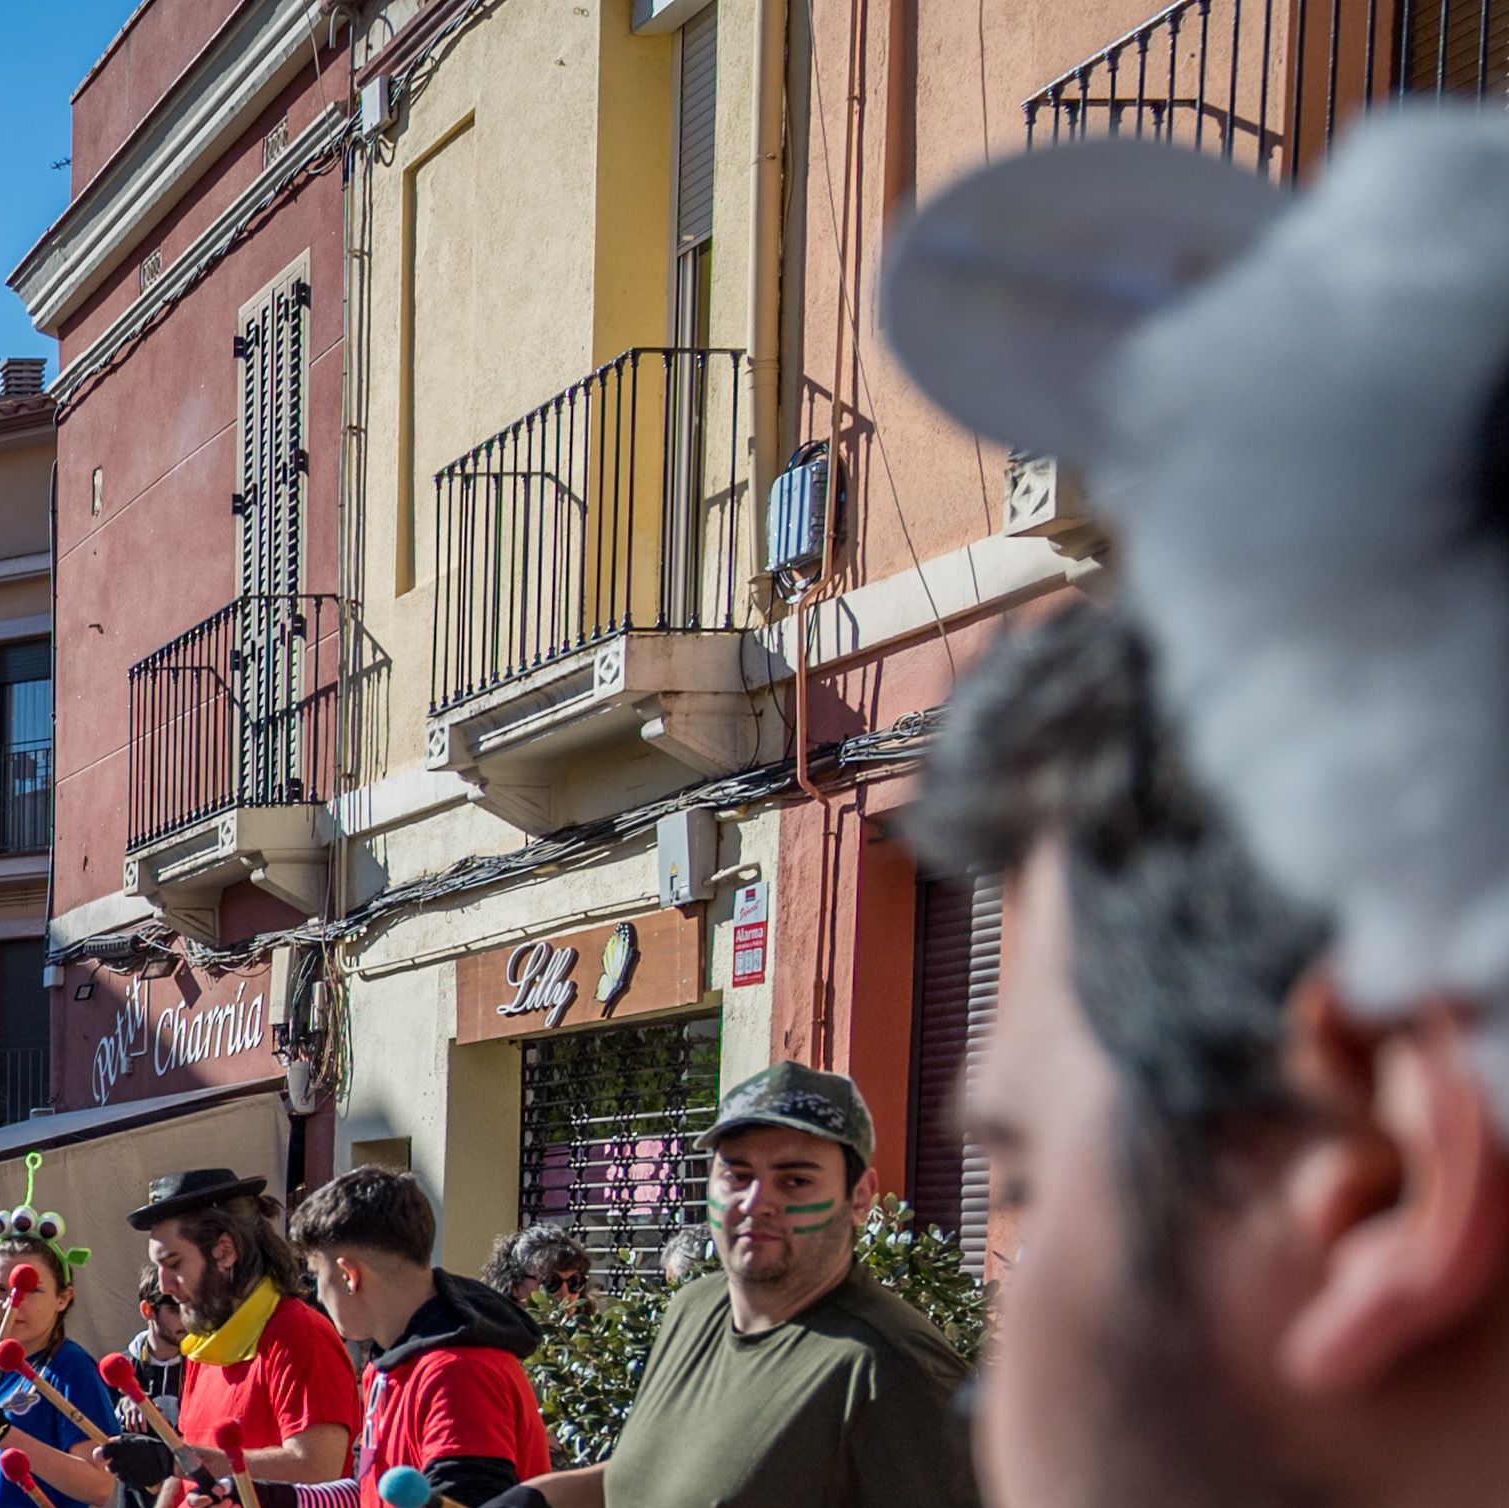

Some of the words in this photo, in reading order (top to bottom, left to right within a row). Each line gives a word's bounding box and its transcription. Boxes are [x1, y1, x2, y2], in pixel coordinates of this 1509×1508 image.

[735, 926, 764, 943] Alarma
[496, 941, 572, 1028] Lilly
[93, 975, 145, 1107] Petit
